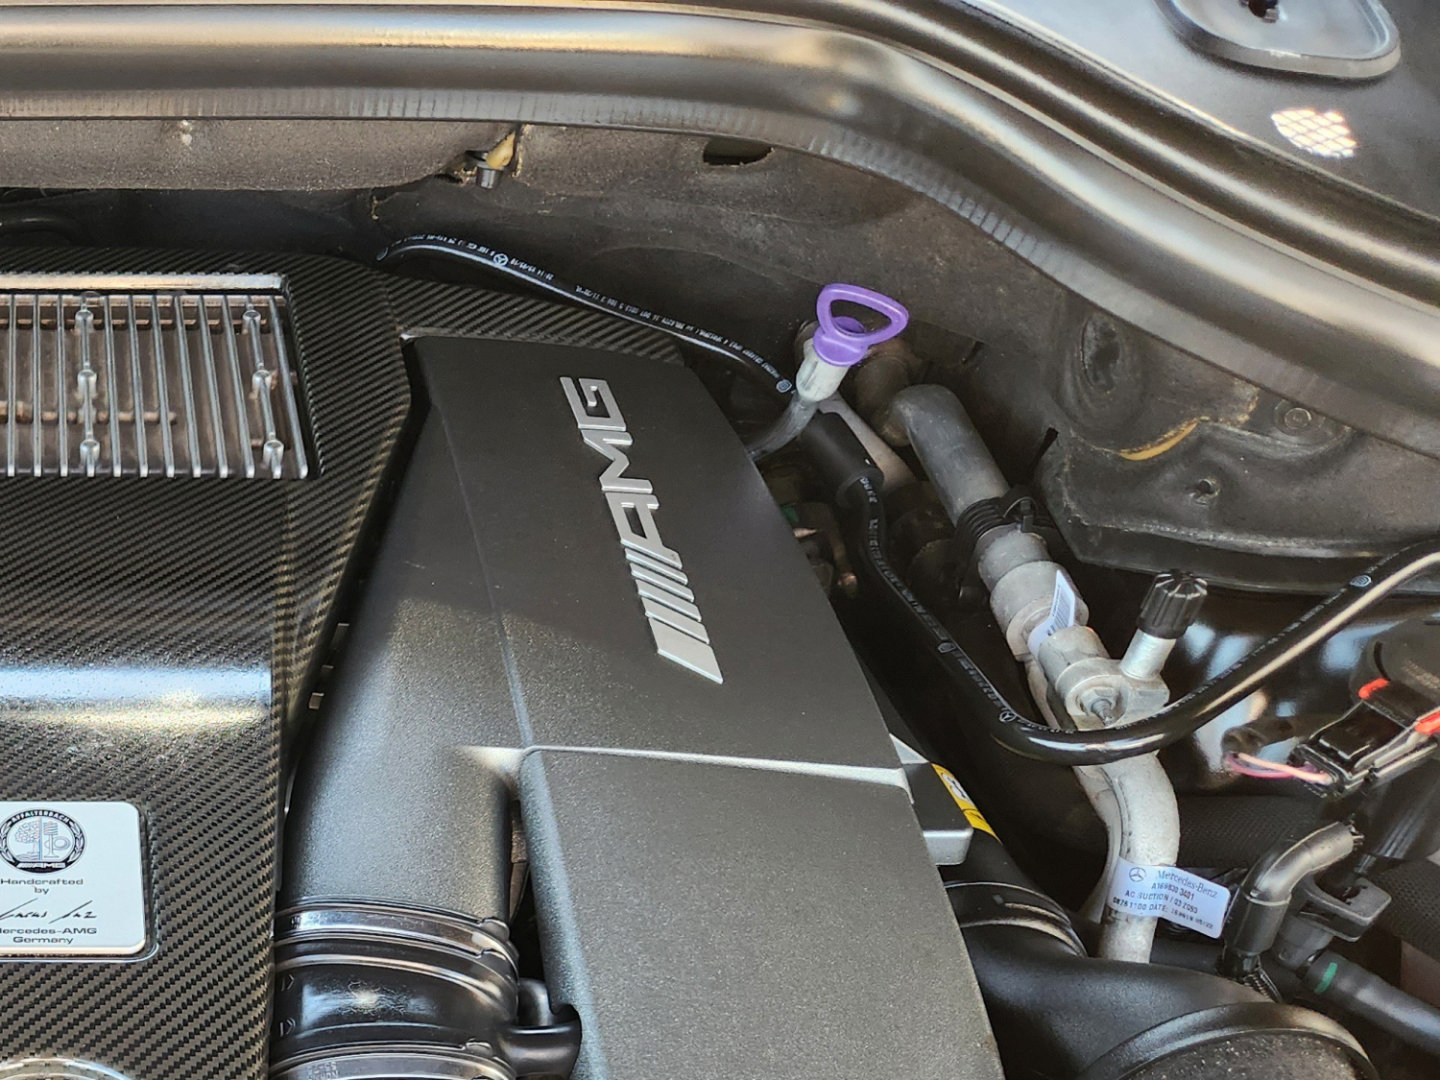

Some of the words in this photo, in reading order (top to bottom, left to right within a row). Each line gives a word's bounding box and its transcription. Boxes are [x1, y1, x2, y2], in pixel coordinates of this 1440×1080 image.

[1157, 869, 1219, 899] Mercedes-Benz
[34, 887, 49, 895] by
[1137, 890, 1170, 902] SUCTION
[13, 936, 74, 944] Germany
